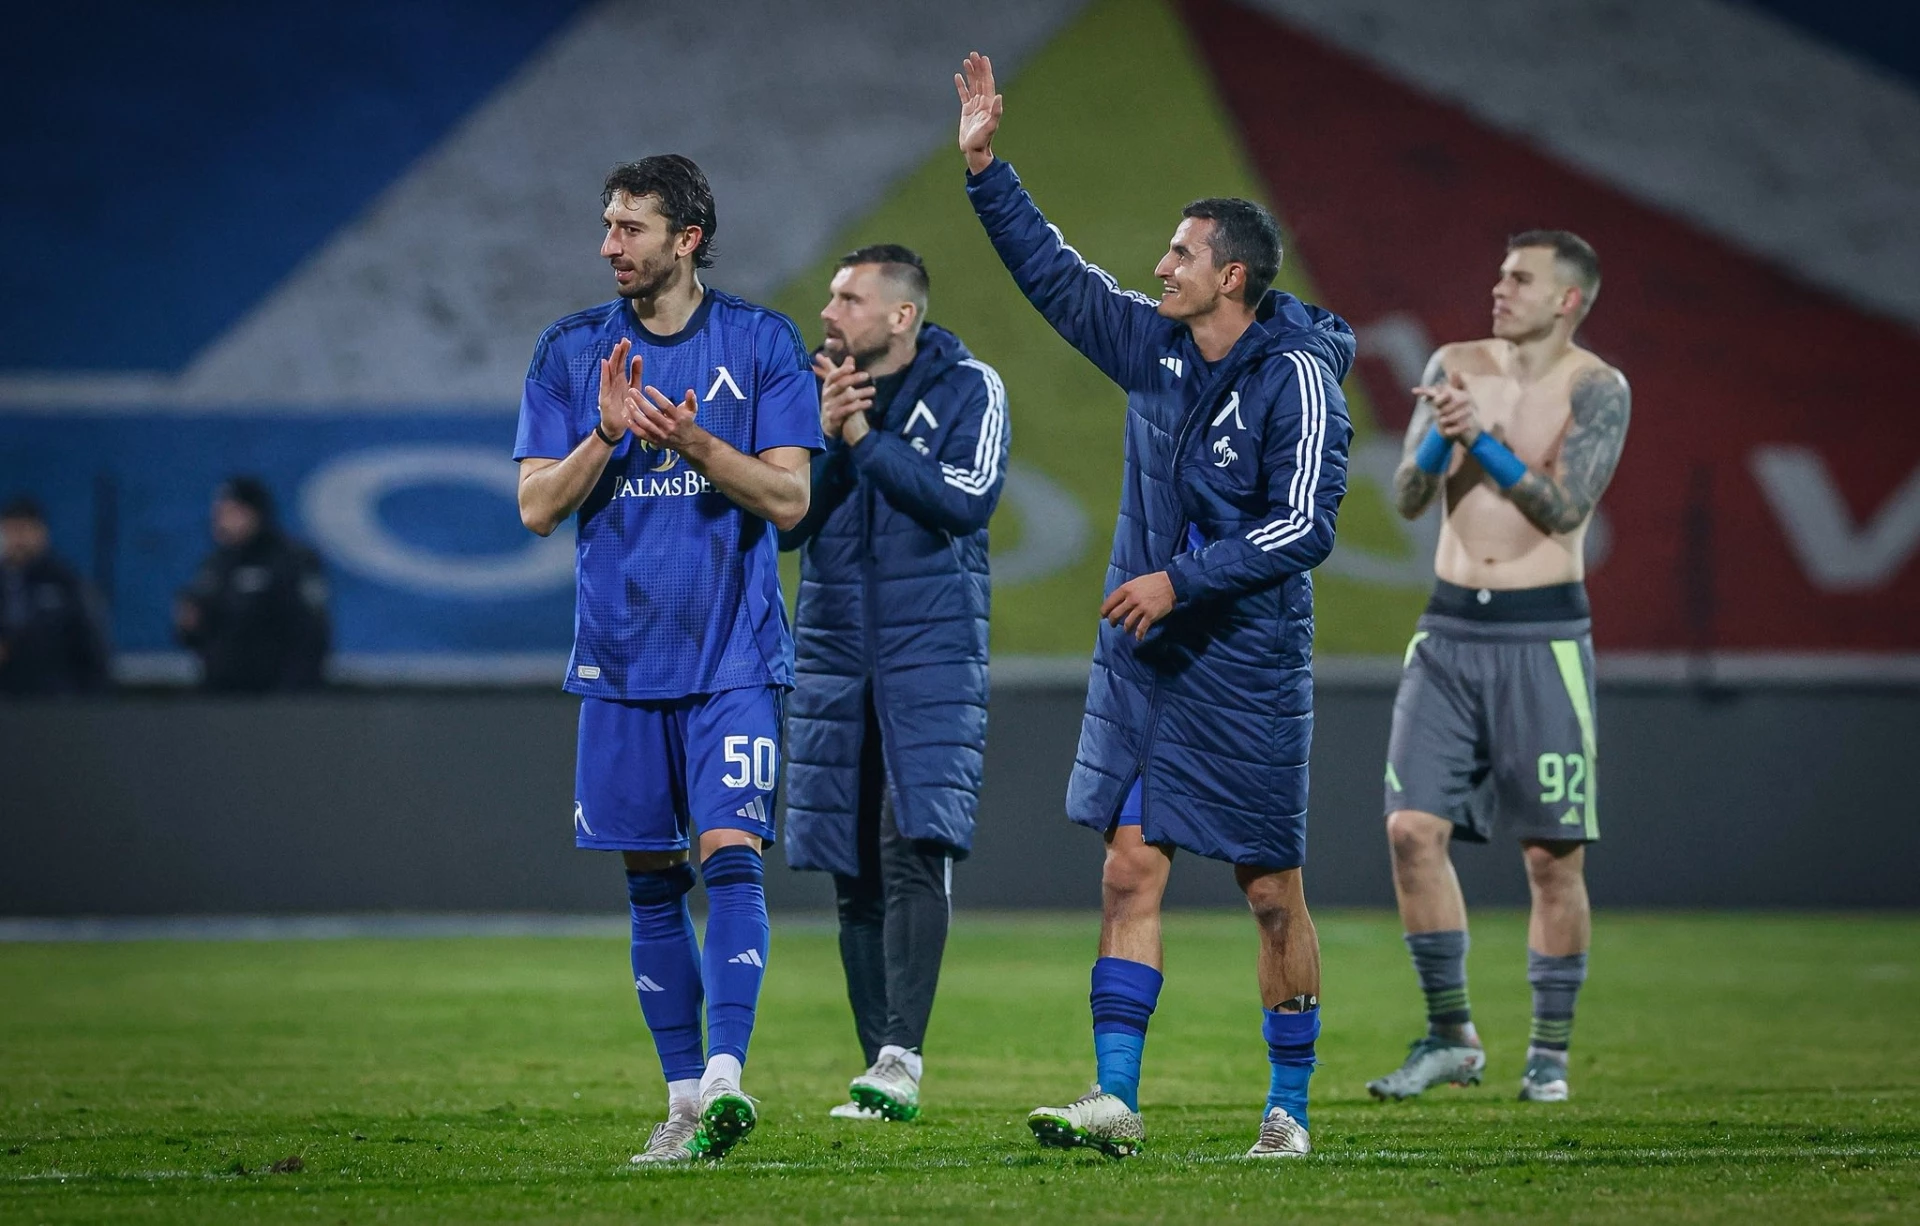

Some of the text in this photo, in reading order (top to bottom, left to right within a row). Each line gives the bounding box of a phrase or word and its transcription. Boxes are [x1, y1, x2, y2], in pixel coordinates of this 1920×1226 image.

[611, 470, 722, 501] PALMSBE
[721, 735, 776, 791] 50
[1537, 752, 1586, 803] 92
